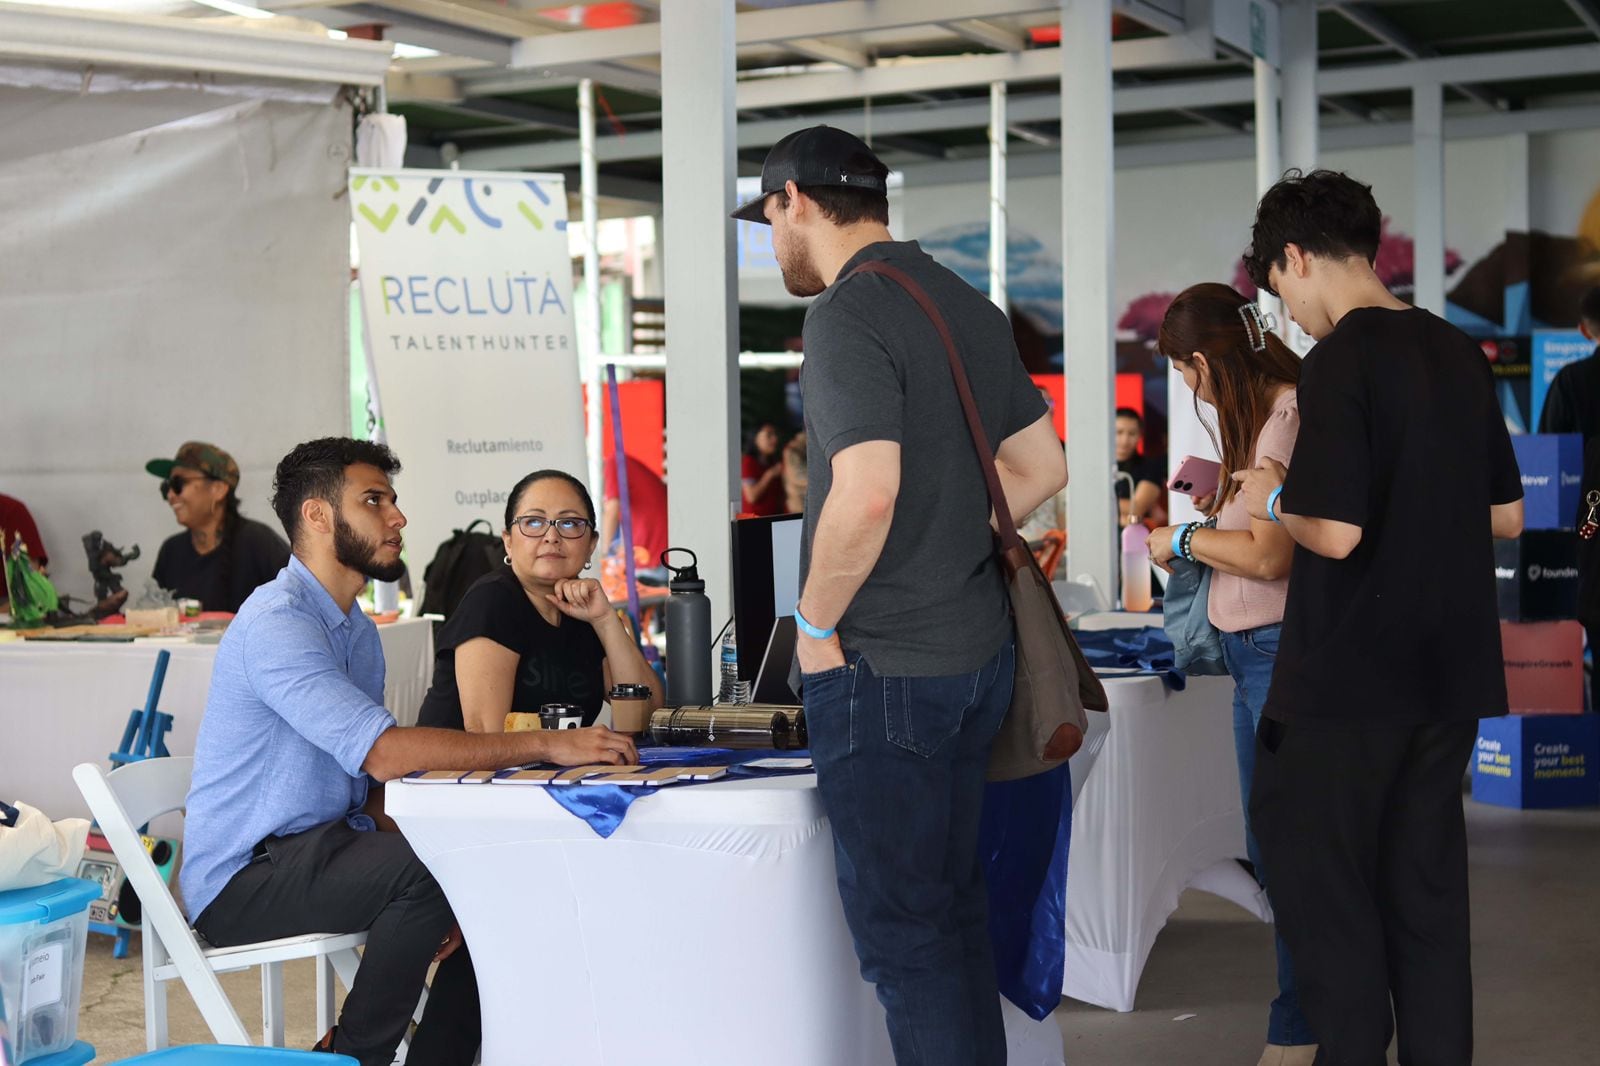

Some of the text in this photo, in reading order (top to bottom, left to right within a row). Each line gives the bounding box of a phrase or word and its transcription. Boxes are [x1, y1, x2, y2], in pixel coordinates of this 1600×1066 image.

[381, 273, 566, 315] RECLUTA
[391, 335, 569, 351] TALENTHUNTER
[447, 438, 543, 454] Reclutamiento
[455, 488, 508, 508] Outplac
[1478, 736, 1501, 752] Create
[1534, 743, 1570, 755] Create
[1477, 750, 1511, 765] your best
[1534, 754, 1585, 769] your best
[1477, 763, 1511, 777] moments
[1534, 767, 1586, 779] moments
